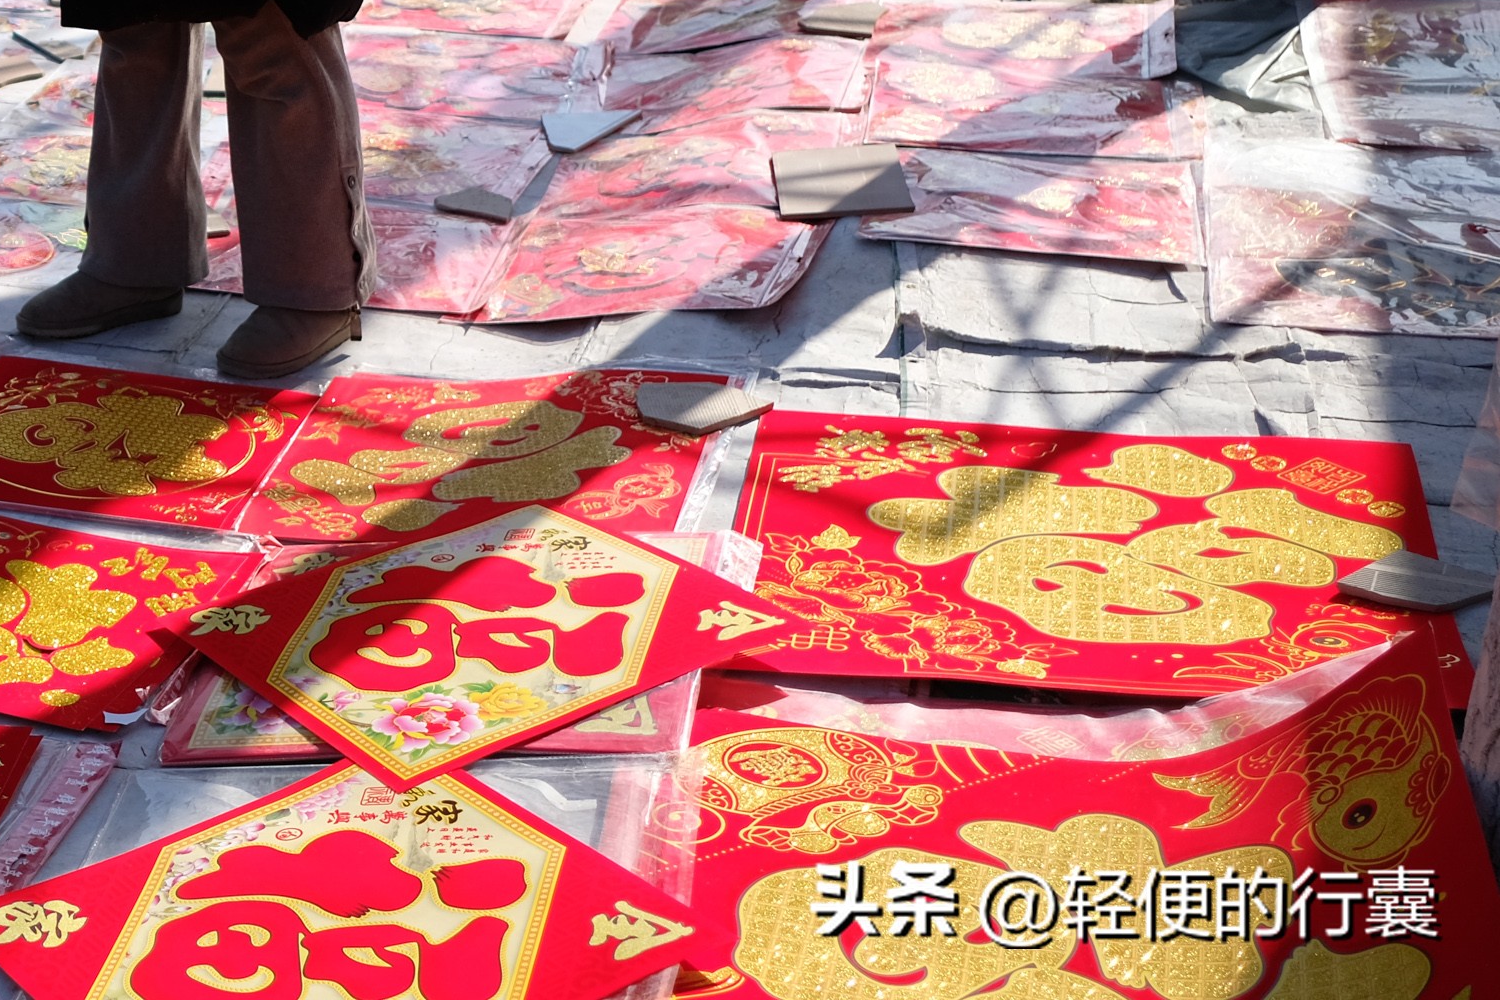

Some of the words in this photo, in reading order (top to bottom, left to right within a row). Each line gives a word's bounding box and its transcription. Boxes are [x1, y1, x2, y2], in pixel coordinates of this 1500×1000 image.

[288, 398, 632, 533] 福
[866, 443, 1405, 645] 福
[189, 603, 272, 637] 家
[307, 554, 647, 693] 福
[696, 601, 787, 641] 全
[326, 808, 410, 826] 萬事興
[129, 829, 528, 999] 福
[588, 899, 696, 961] 全
